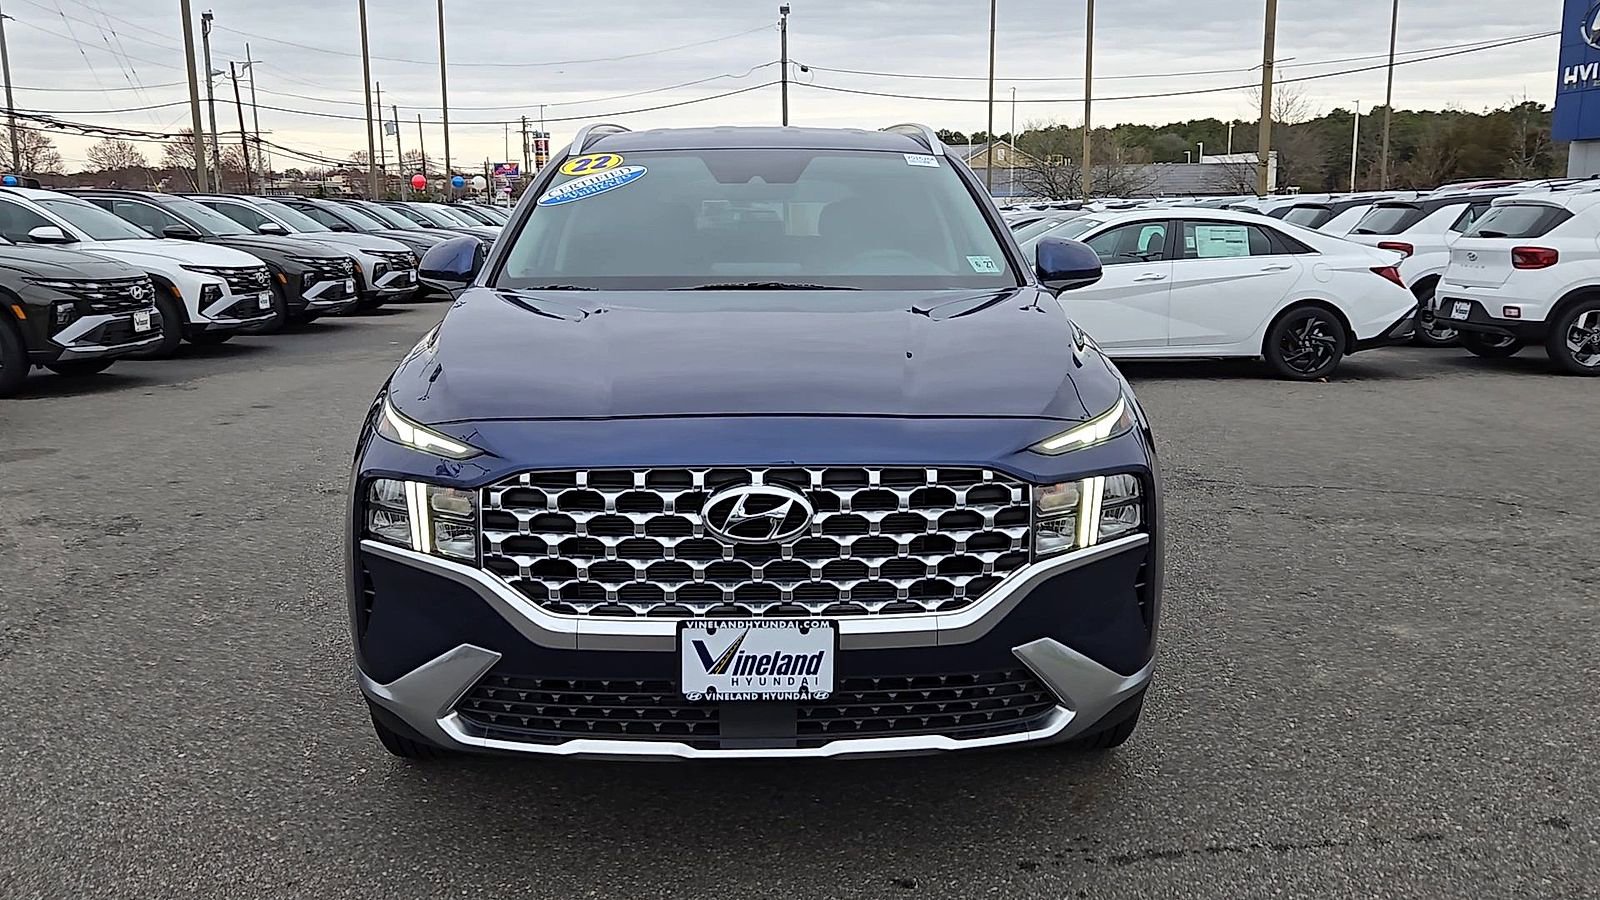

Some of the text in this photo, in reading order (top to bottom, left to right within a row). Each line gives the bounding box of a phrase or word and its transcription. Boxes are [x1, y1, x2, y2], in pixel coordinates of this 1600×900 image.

[571, 155, 612, 173] 22
[548, 167, 632, 197] CERTIFIED
[686, 620, 830, 629] VINELANDHYUNDAI.COM
[691, 628, 826, 676] Vineland
[731, 676, 818, 687] HYUNDAI
[704, 692, 812, 701] VINELAND HYUNDAI
